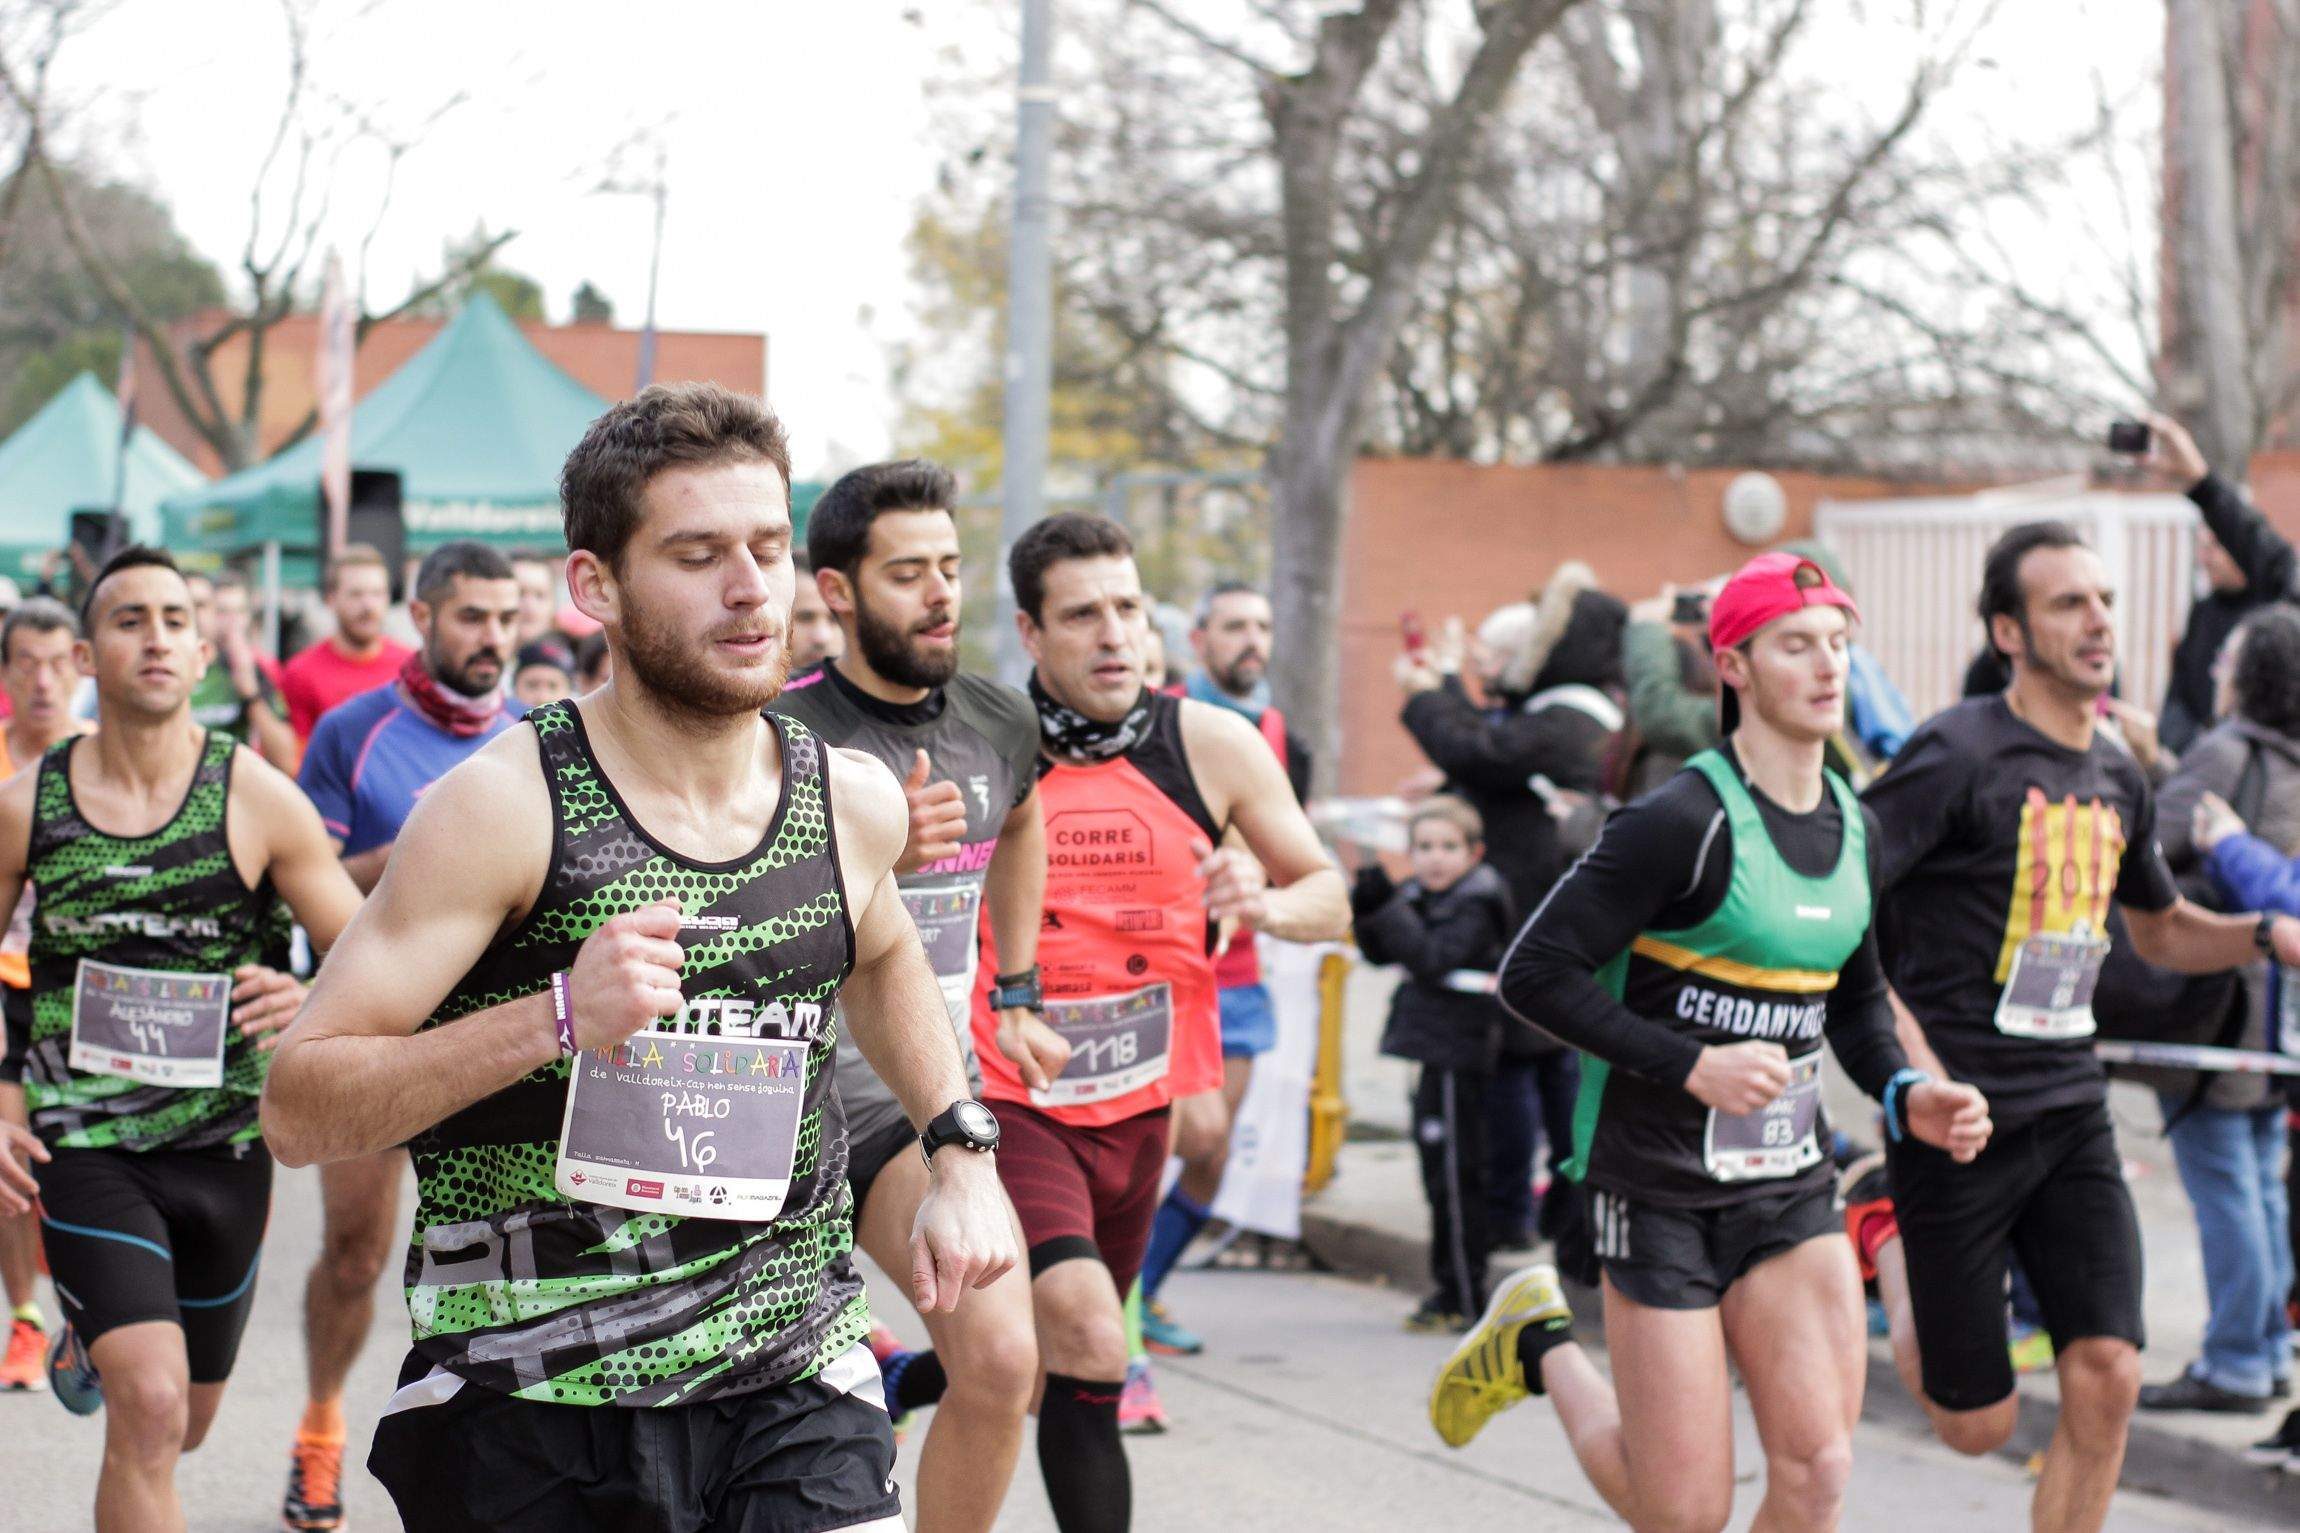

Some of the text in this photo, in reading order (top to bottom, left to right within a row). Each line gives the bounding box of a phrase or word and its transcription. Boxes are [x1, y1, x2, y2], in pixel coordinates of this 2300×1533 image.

[1056, 829, 1132, 846] CORRE
[129, 1020, 168, 1055] 44
[597, 1040, 800, 1078] MILLA SOLIDARIA
[589, 1066, 607, 1079] de
[708, 1081, 726, 1090] nen
[727, 1083, 756, 1093] sense
[757, 1083, 795, 1095] joguina
[661, 1090, 731, 1119] PABLO
[665, 1118, 717, 1173] 46
